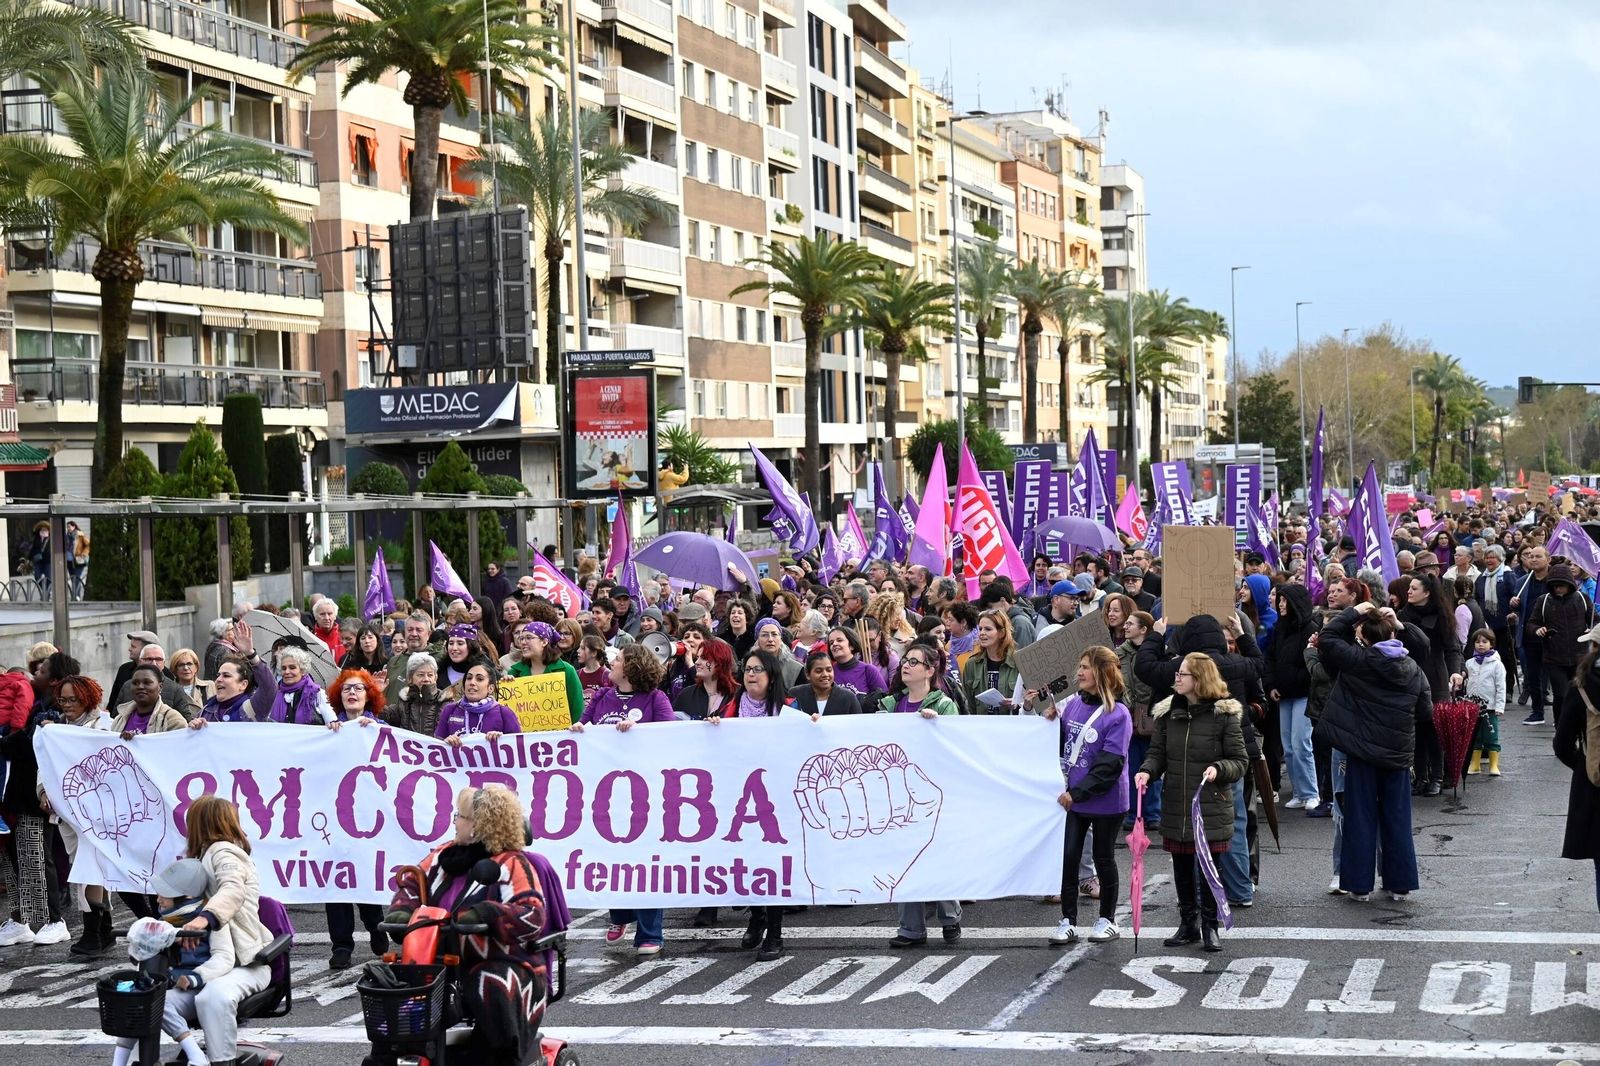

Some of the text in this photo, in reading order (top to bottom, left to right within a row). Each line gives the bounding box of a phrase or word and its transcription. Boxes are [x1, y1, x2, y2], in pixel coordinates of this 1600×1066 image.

[571, 353, 591, 361] PARADA
[591, 353, 602, 361] TAXI
[605, 352, 624, 360] PUERTA
[624, 352, 650, 360] GALLEGOS
[397, 391, 480, 414] MEDAC
[417, 450, 435, 465] Eli
[476, 446, 513, 462] líder
[542, 697, 565, 712] QUE
[532, 713, 571, 728] ABUSOS
[369, 727, 579, 769] Asamblea
[335, 764, 789, 845] CÓDOBA
[272, 849, 358, 890] viva
[565, 848, 793, 898] feminista!
